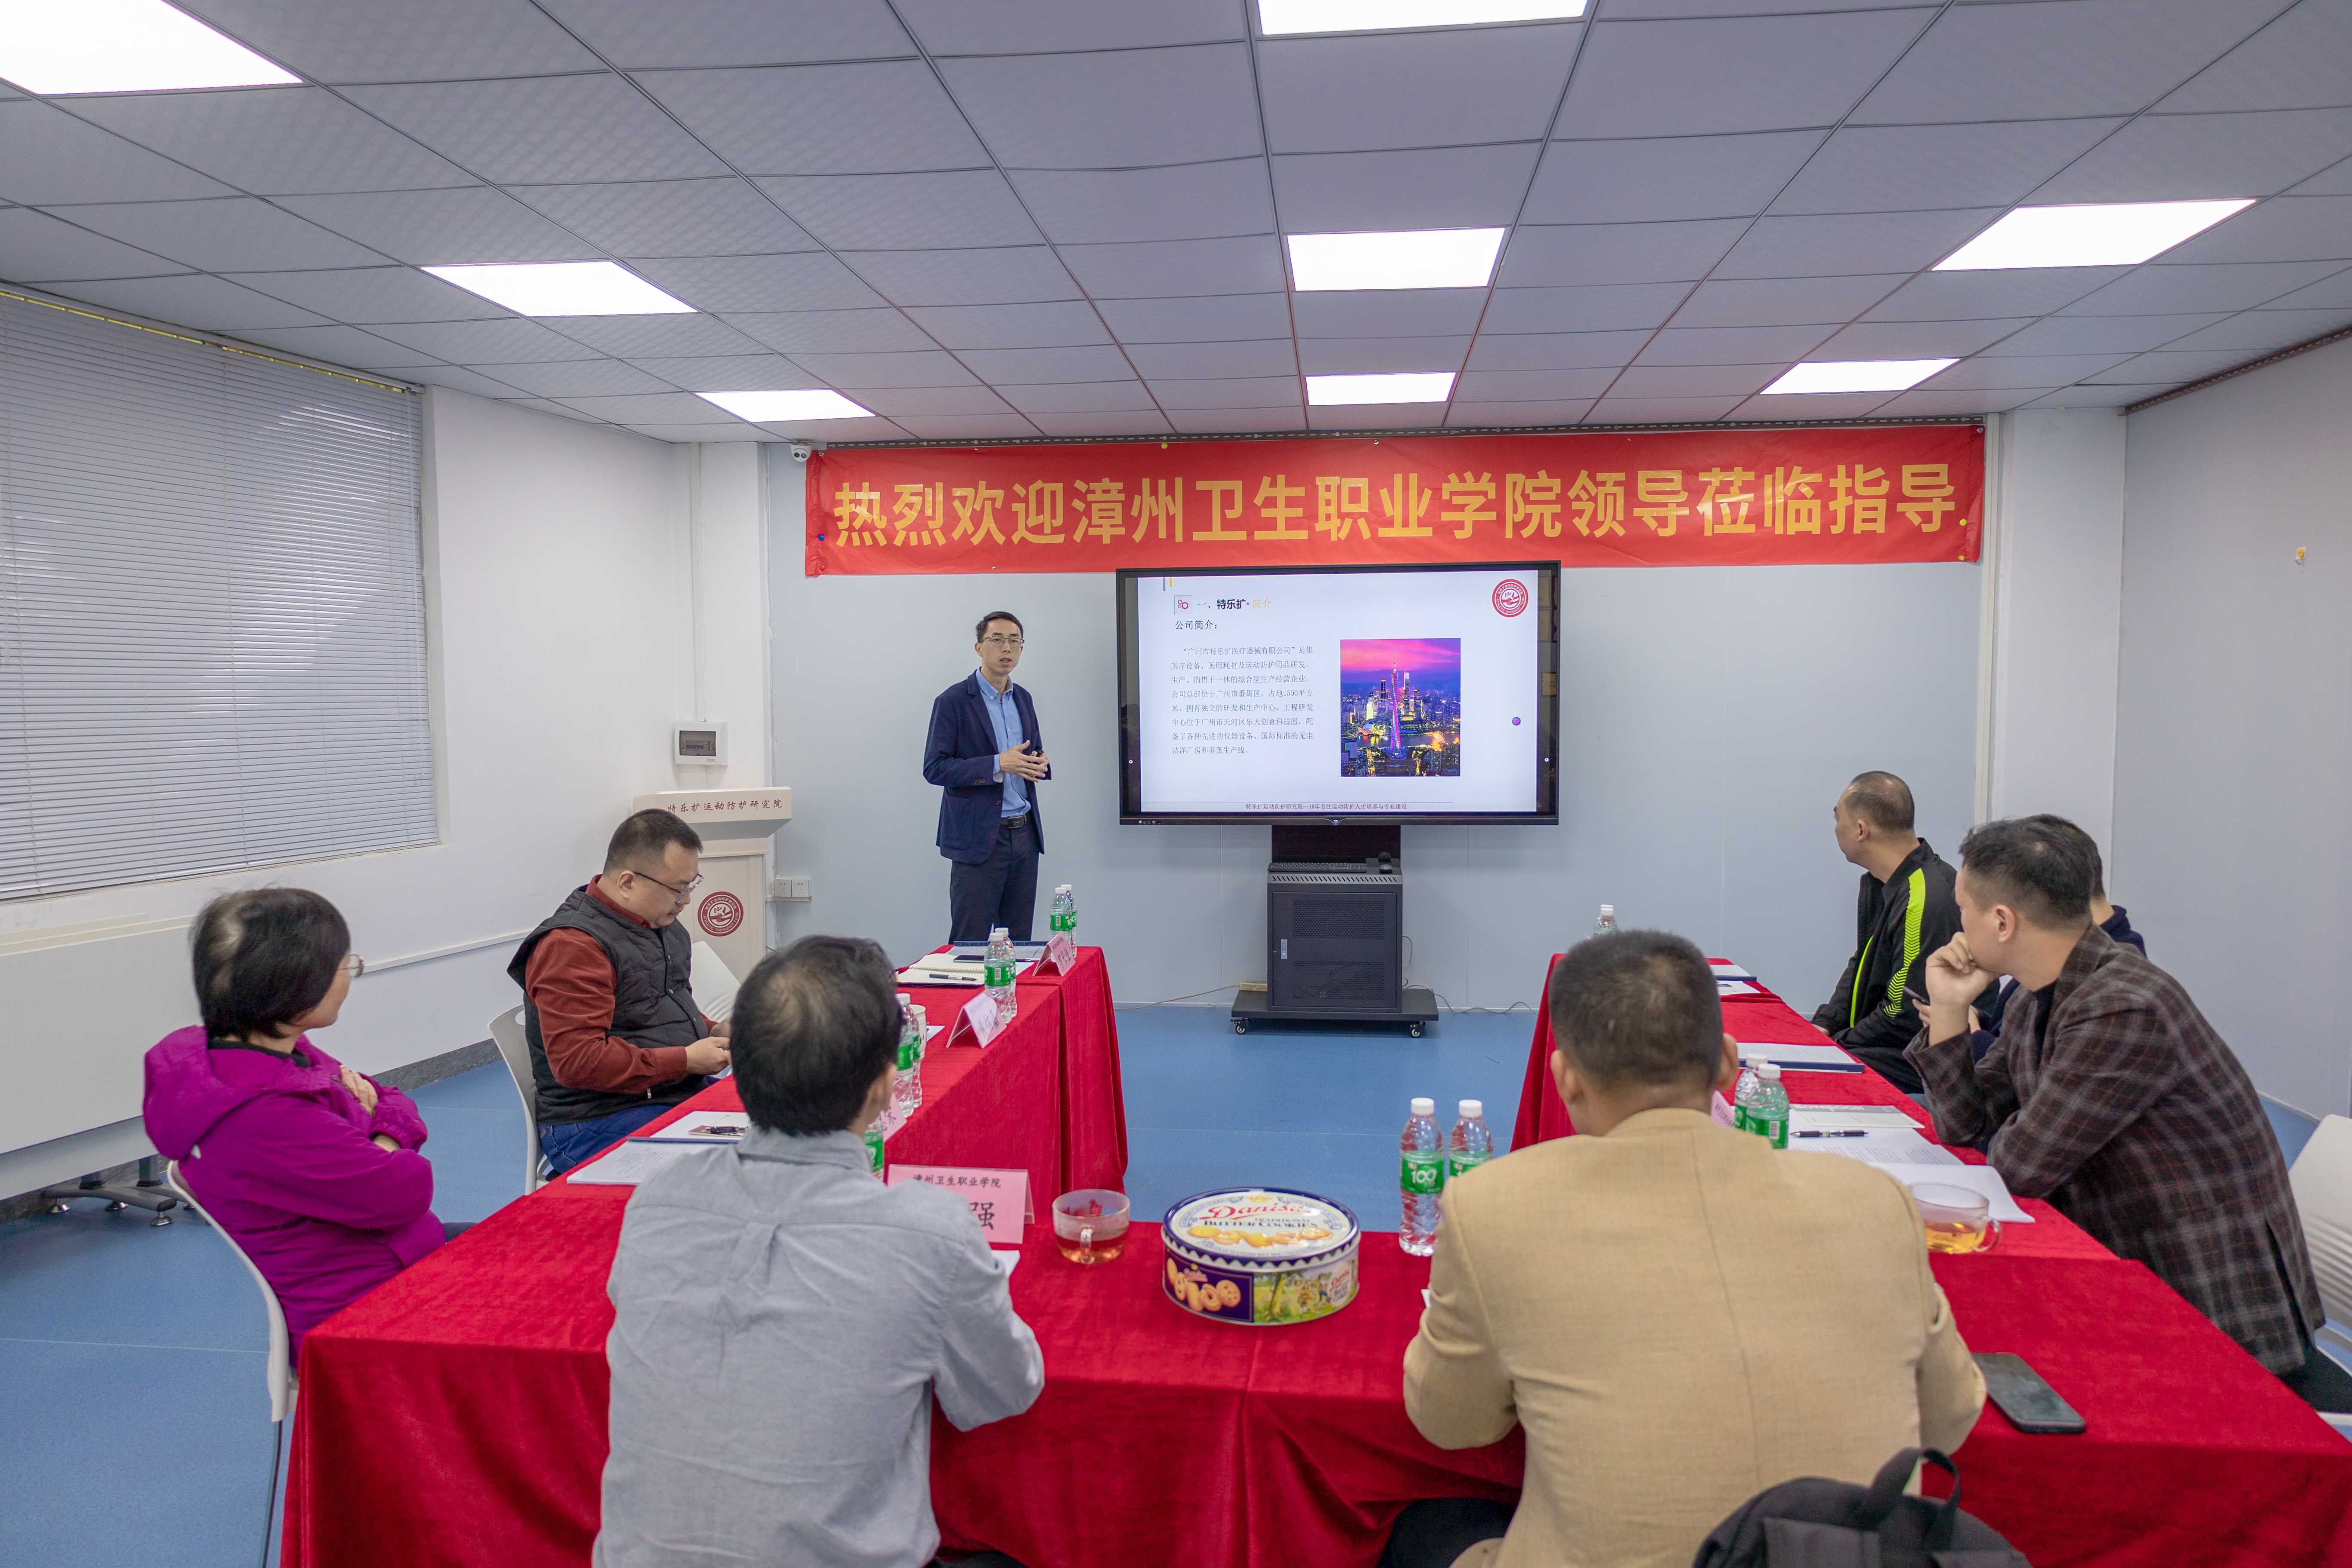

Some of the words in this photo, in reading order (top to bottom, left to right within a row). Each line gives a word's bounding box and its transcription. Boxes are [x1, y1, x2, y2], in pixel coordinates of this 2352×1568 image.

[834, 463, 1957, 547] 热烈欢迎漳州卫生职业学院领导莅临指导
[1253, 598, 1272, 609] 简介
[668, 799, 783, 813] 特乐扩运动防护研究院
[913, 1174, 1001, 1188] 漳州卫生职业学院
[1411, 1169, 1437, 1184] 100
[970, 1202, 995, 1230] 强
